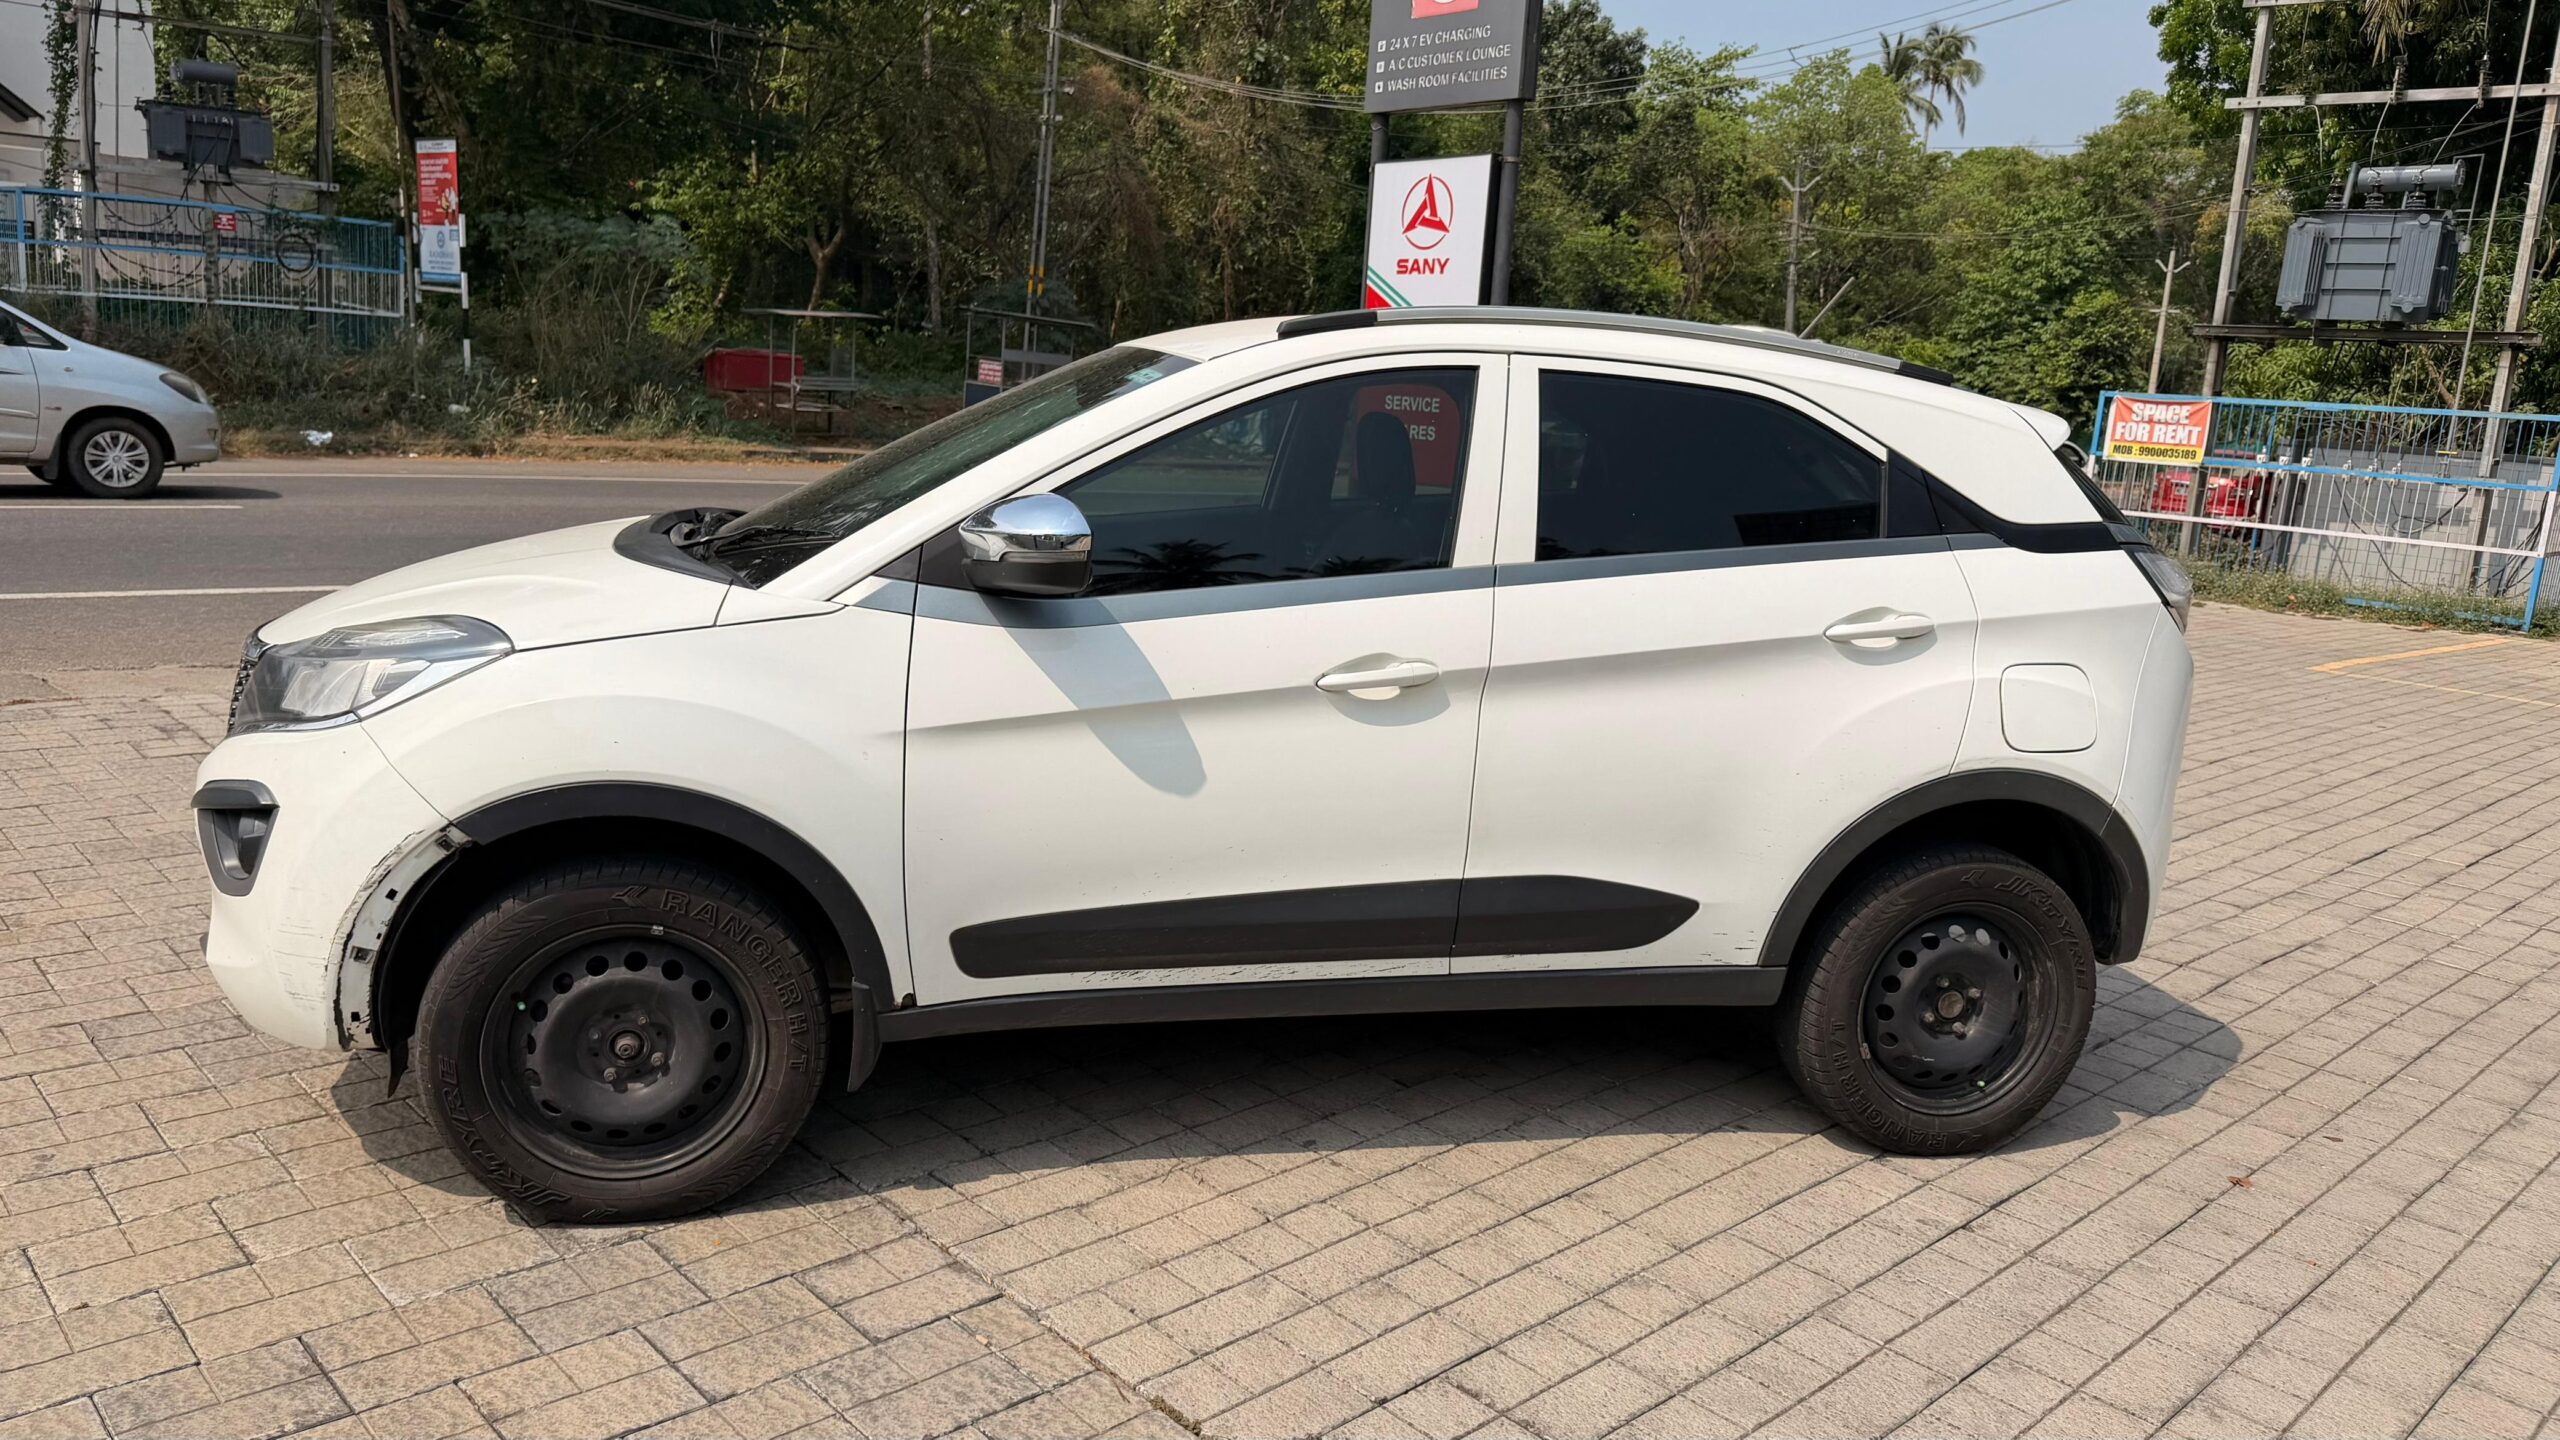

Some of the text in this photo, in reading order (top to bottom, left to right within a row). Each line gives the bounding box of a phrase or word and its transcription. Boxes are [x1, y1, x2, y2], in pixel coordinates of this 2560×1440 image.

[1389, 39, 1401, 51] 24
[1411, 36, 1418, 48] 7
[1419, 34, 1434, 47] EV
[1435, 25, 1491, 45] CHARGING
[1407, 51, 1464, 69] CUSTOMER
[1465, 44, 1512, 62] LOUNGE
[1387, 66, 1508, 92] WASH ROOM FACILITIES
[1396, 258, 1450, 275] SANY
[1384, 395, 1441, 413] SERVICE
[2131, 402, 2191, 424] SPACE
[2114, 422, 2201, 445] FOR RENT
[659, 888, 803, 1009] RANGER
[1840, 1071, 1948, 1151] RANGER
